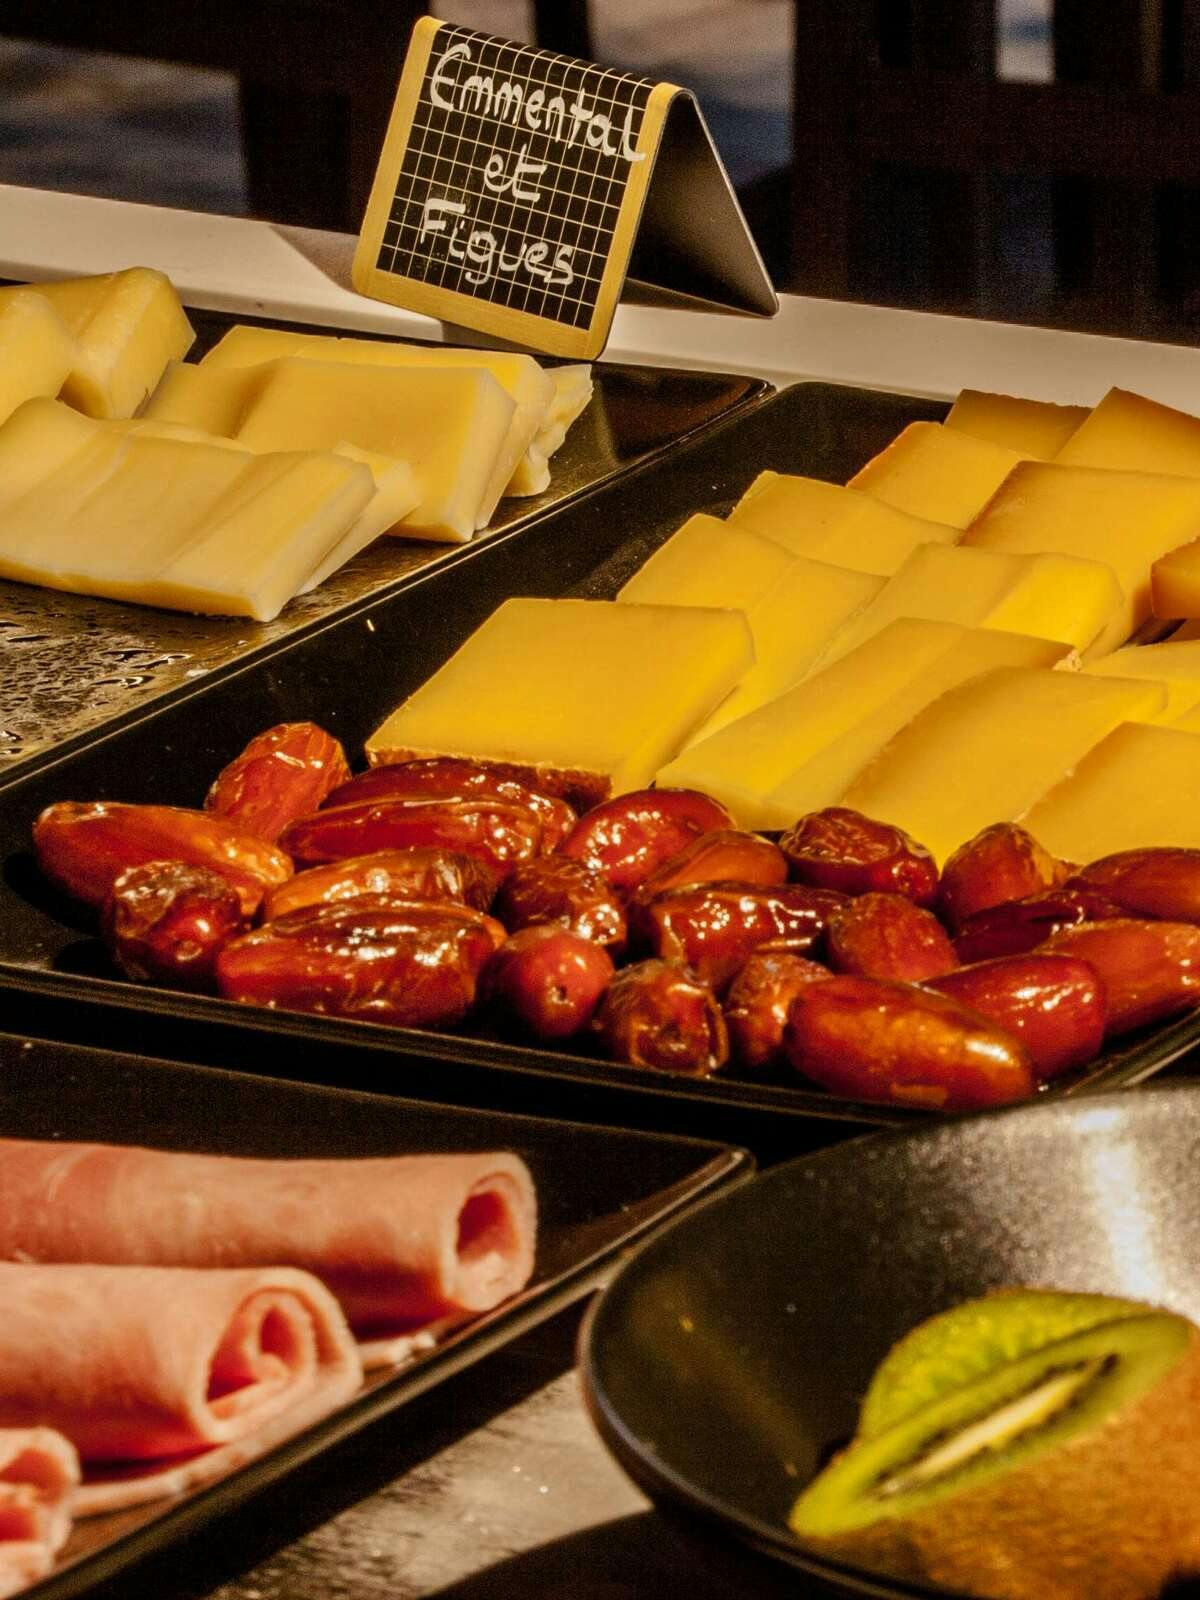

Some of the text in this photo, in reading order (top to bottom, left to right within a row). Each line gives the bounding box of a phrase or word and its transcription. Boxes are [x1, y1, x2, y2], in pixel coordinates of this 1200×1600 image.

[429, 43, 646, 162] Emmental
[482, 144, 547, 201] et
[420, 198, 574, 285] Figues
